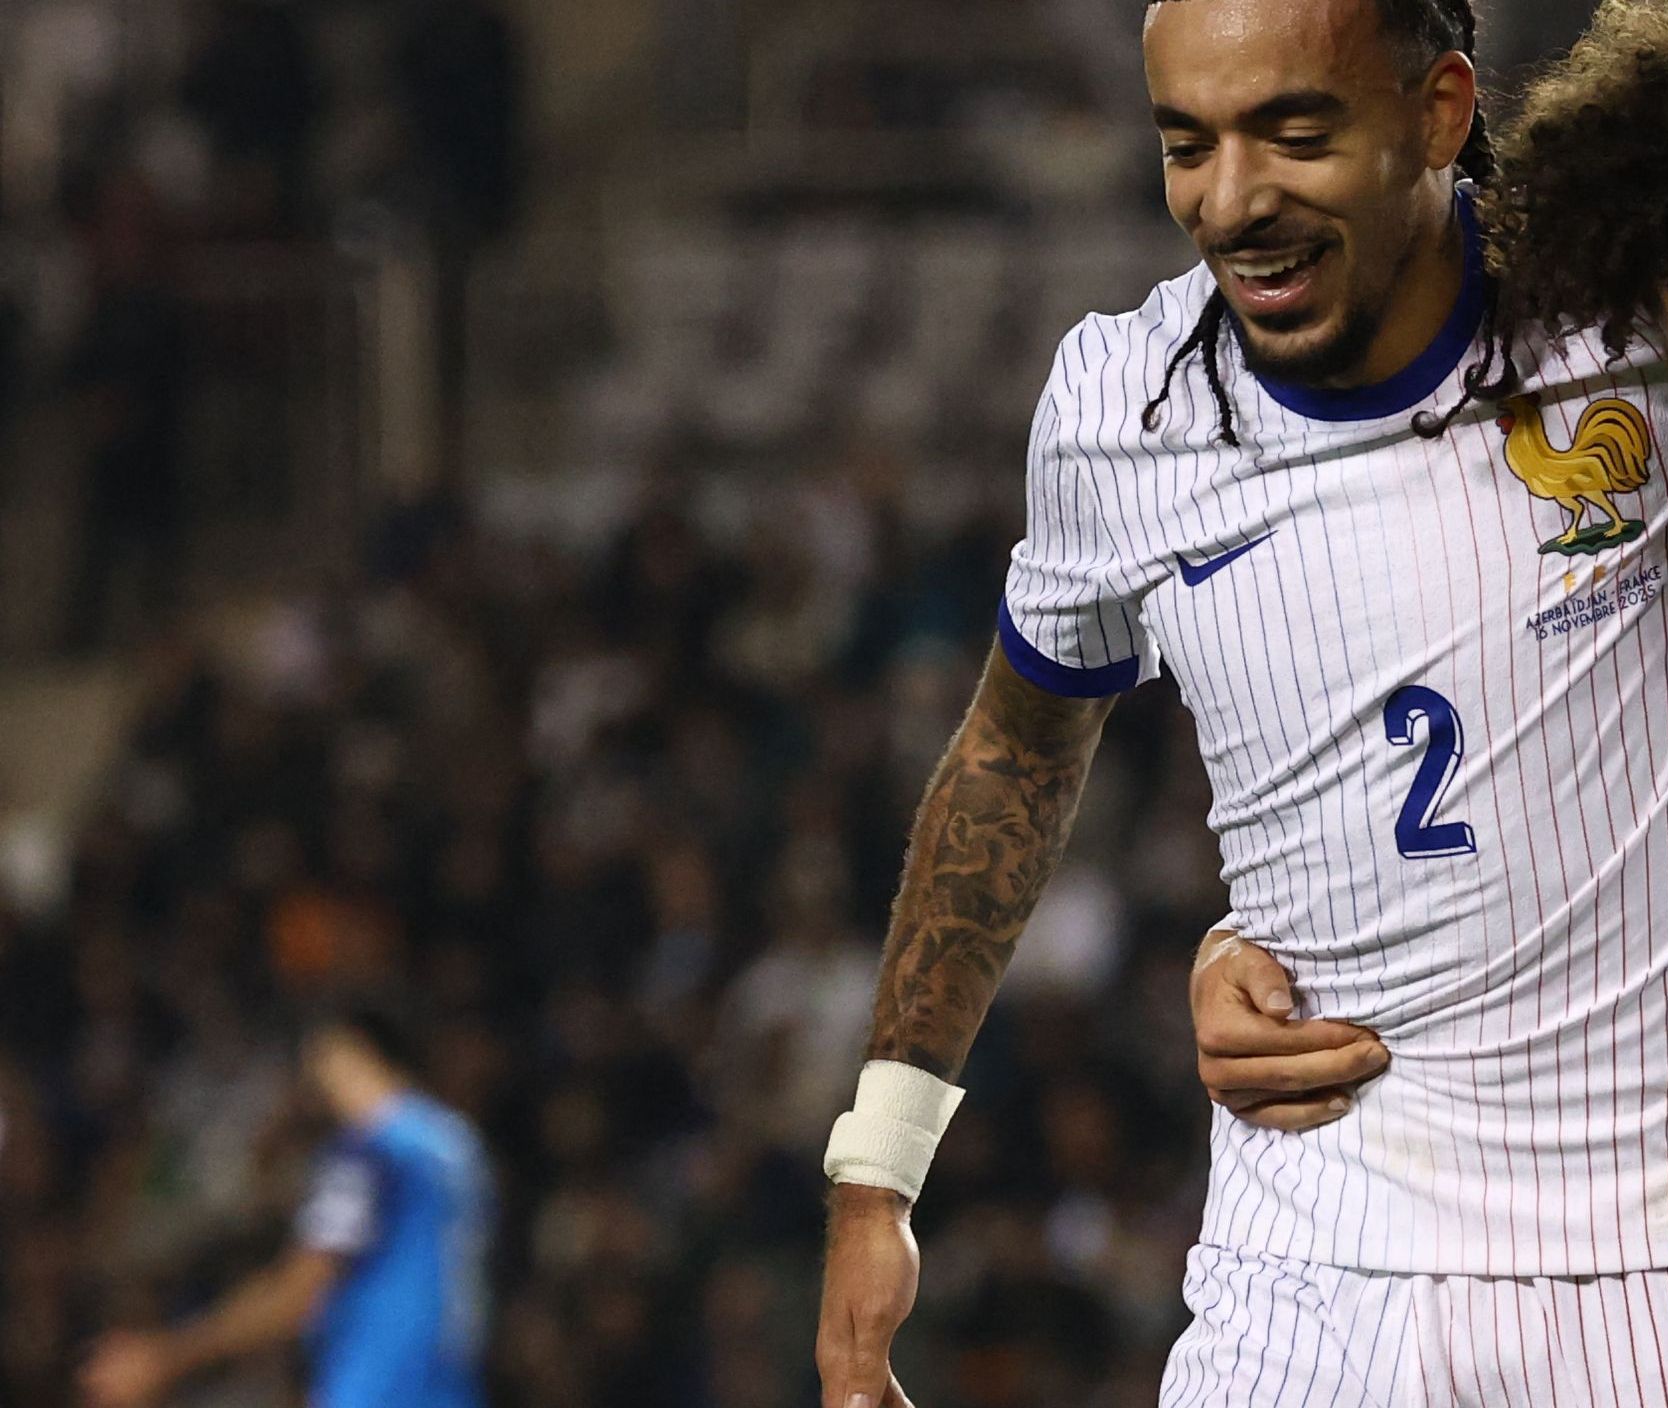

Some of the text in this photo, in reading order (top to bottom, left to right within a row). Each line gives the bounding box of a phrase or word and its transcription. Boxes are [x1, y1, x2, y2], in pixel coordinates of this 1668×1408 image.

[1618, 565, 1662, 596] FRANCE
[1551, 600, 1616, 637] NOVEMBRE
[1618, 584, 1657, 611] 2025
[1383, 684, 1477, 860] 2
